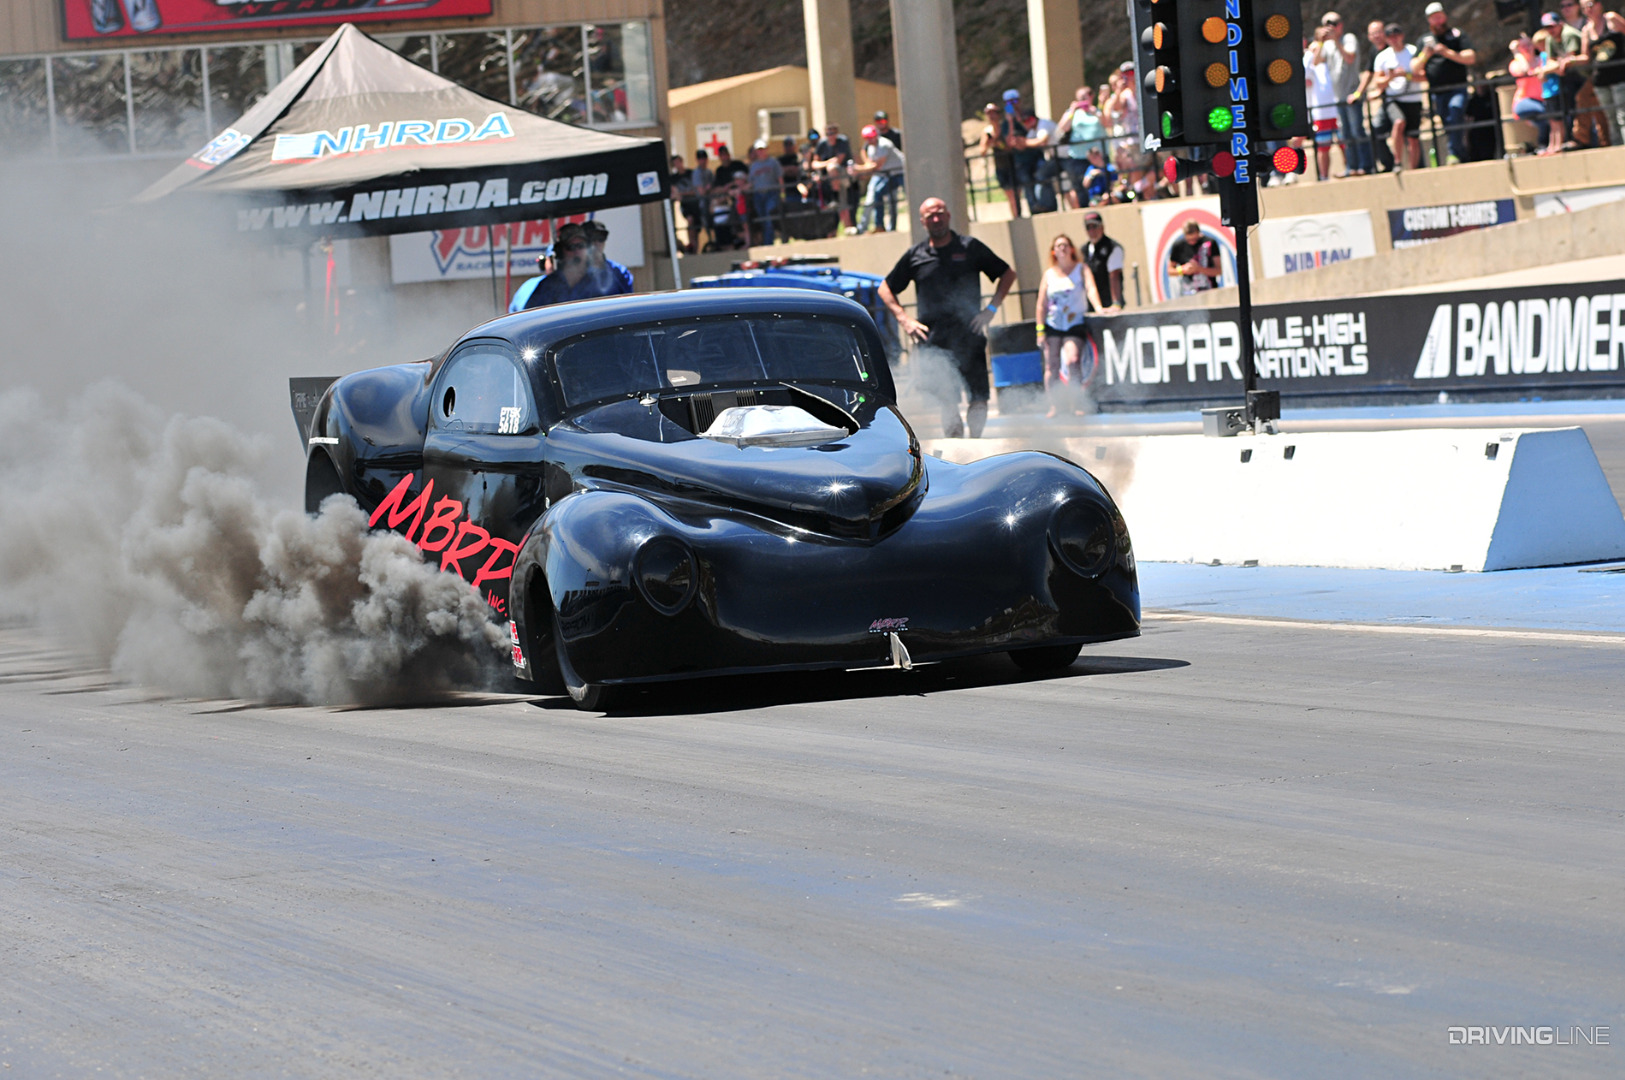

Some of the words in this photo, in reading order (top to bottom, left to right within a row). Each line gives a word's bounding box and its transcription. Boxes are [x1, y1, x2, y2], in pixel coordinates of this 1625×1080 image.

[311, 111, 515, 158] NHRDA
[236, 172, 609, 232] www.NHRDA.com
[1403, 206, 1450, 231] CUSTOM
[1103, 320, 1243, 385] MOPAR
[1253, 344, 1370, 380] NATIONALS
[487, 589, 508, 617] INC.
